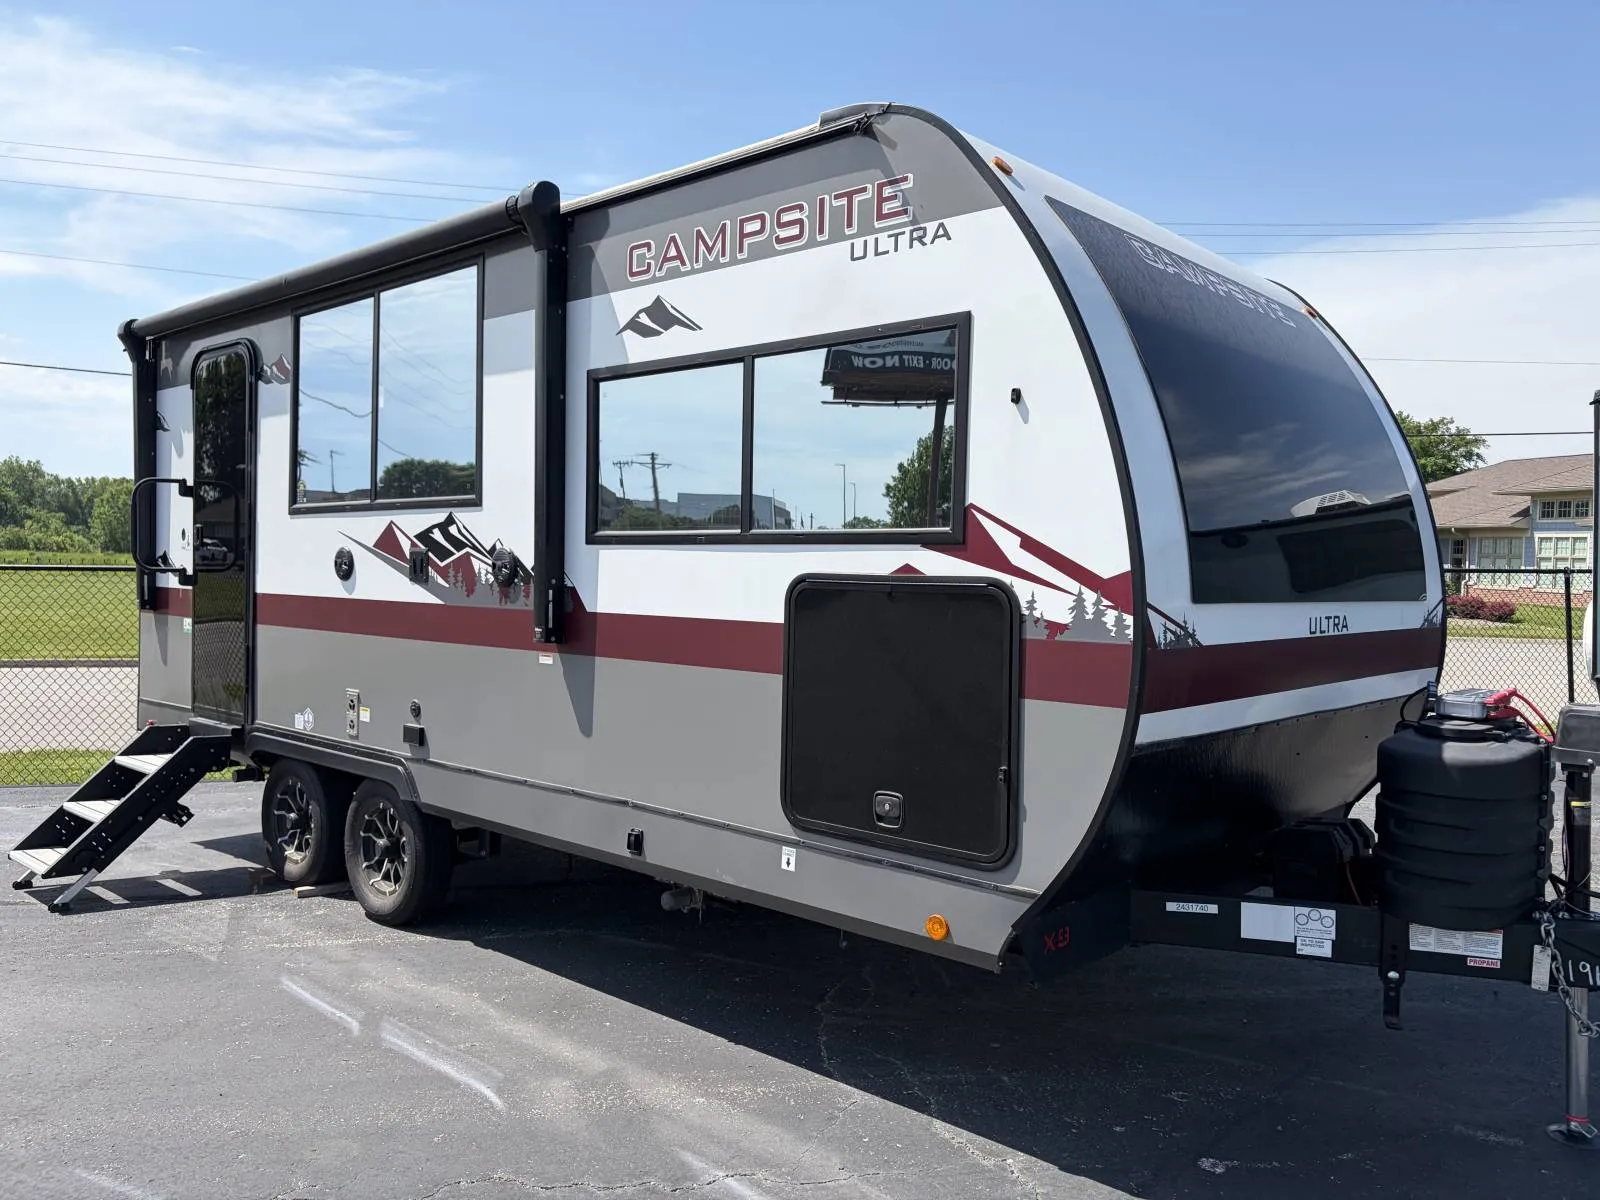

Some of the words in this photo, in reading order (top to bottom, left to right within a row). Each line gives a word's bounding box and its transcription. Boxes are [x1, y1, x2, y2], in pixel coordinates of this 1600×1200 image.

[627, 173, 913, 282] CAMPSITE
[850, 222, 952, 262] ULTRA
[1308, 614, 1349, 636] ULTRA
[1175, 903, 1209, 913] 2431740
[1468, 958, 1499, 968] PROPANE
